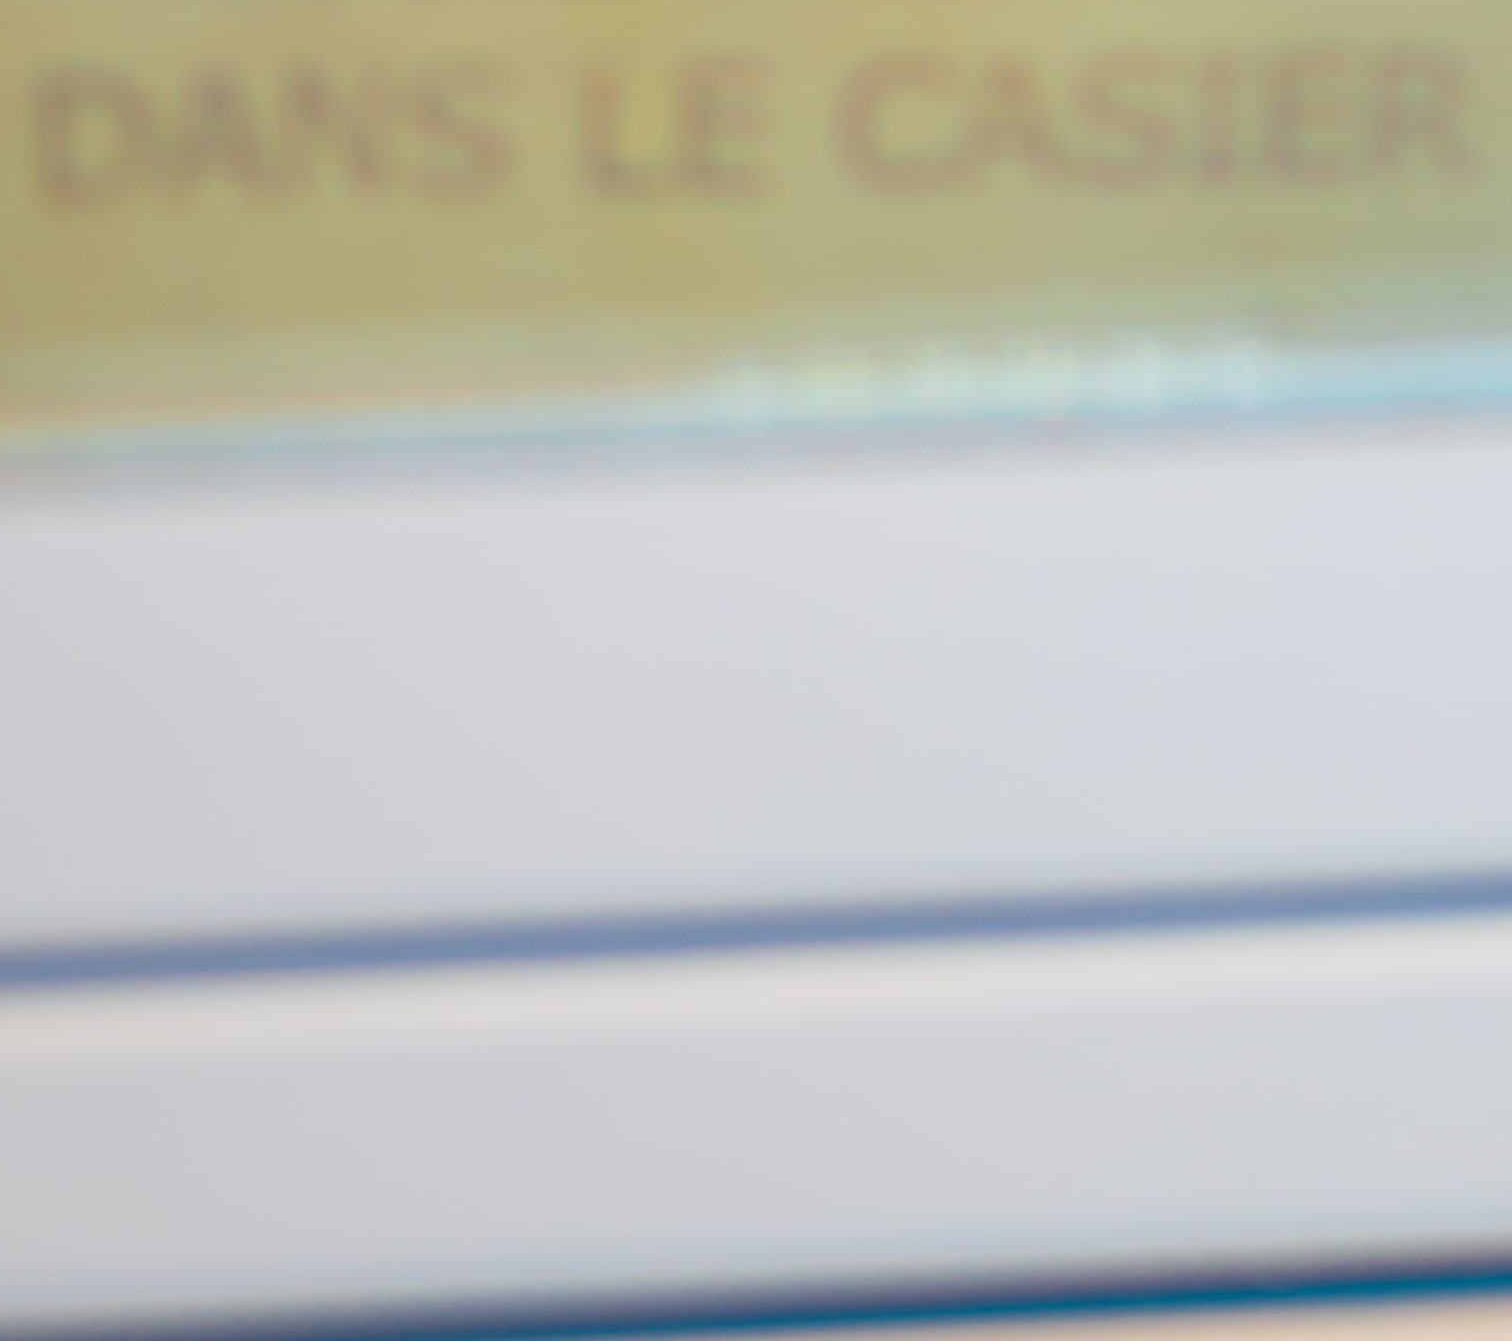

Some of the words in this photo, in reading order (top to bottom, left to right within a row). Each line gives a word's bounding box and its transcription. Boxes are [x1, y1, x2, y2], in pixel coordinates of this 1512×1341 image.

[28, 57, 515, 213] DANS
[574, 52, 767, 203] LE
[833, 42, 1481, 195] CASIER
